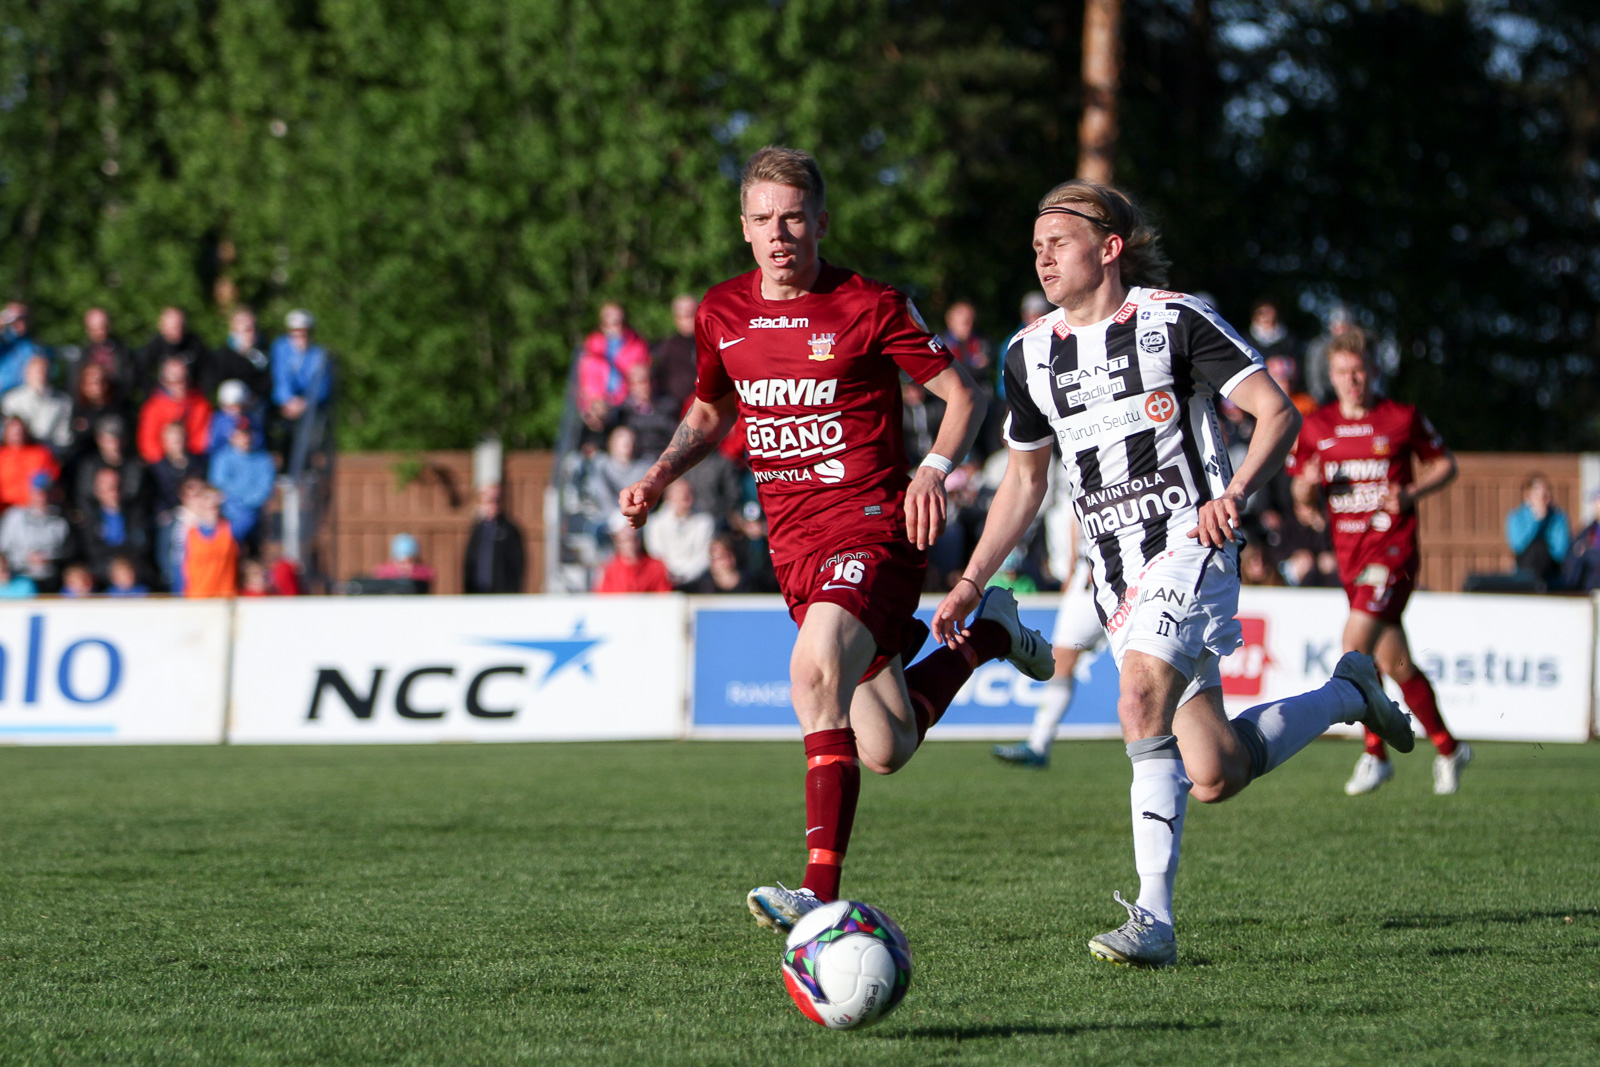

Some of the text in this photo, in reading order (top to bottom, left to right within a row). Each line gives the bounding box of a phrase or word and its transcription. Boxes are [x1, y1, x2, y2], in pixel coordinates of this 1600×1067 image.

[749, 316, 809, 329] stadium
[1115, 303, 1137, 322] FELIX
[1053, 321, 1071, 339] FELIX
[1058, 357, 1126, 386] GANT
[734, 378, 838, 407] HARVIA
[1069, 381, 1124, 406] stadium
[746, 420, 843, 450] GRANO
[1066, 423, 1101, 441] Turun
[1102, 410, 1141, 430] Seutu
[1085, 473, 1166, 508] RAVINTOLA
[1084, 485, 1188, 539] mauno
[832, 560, 866, 584] 16
[1156, 620, 1170, 637] 11
[0, 613, 122, 705] lo
[303, 665, 531, 721] NCC
